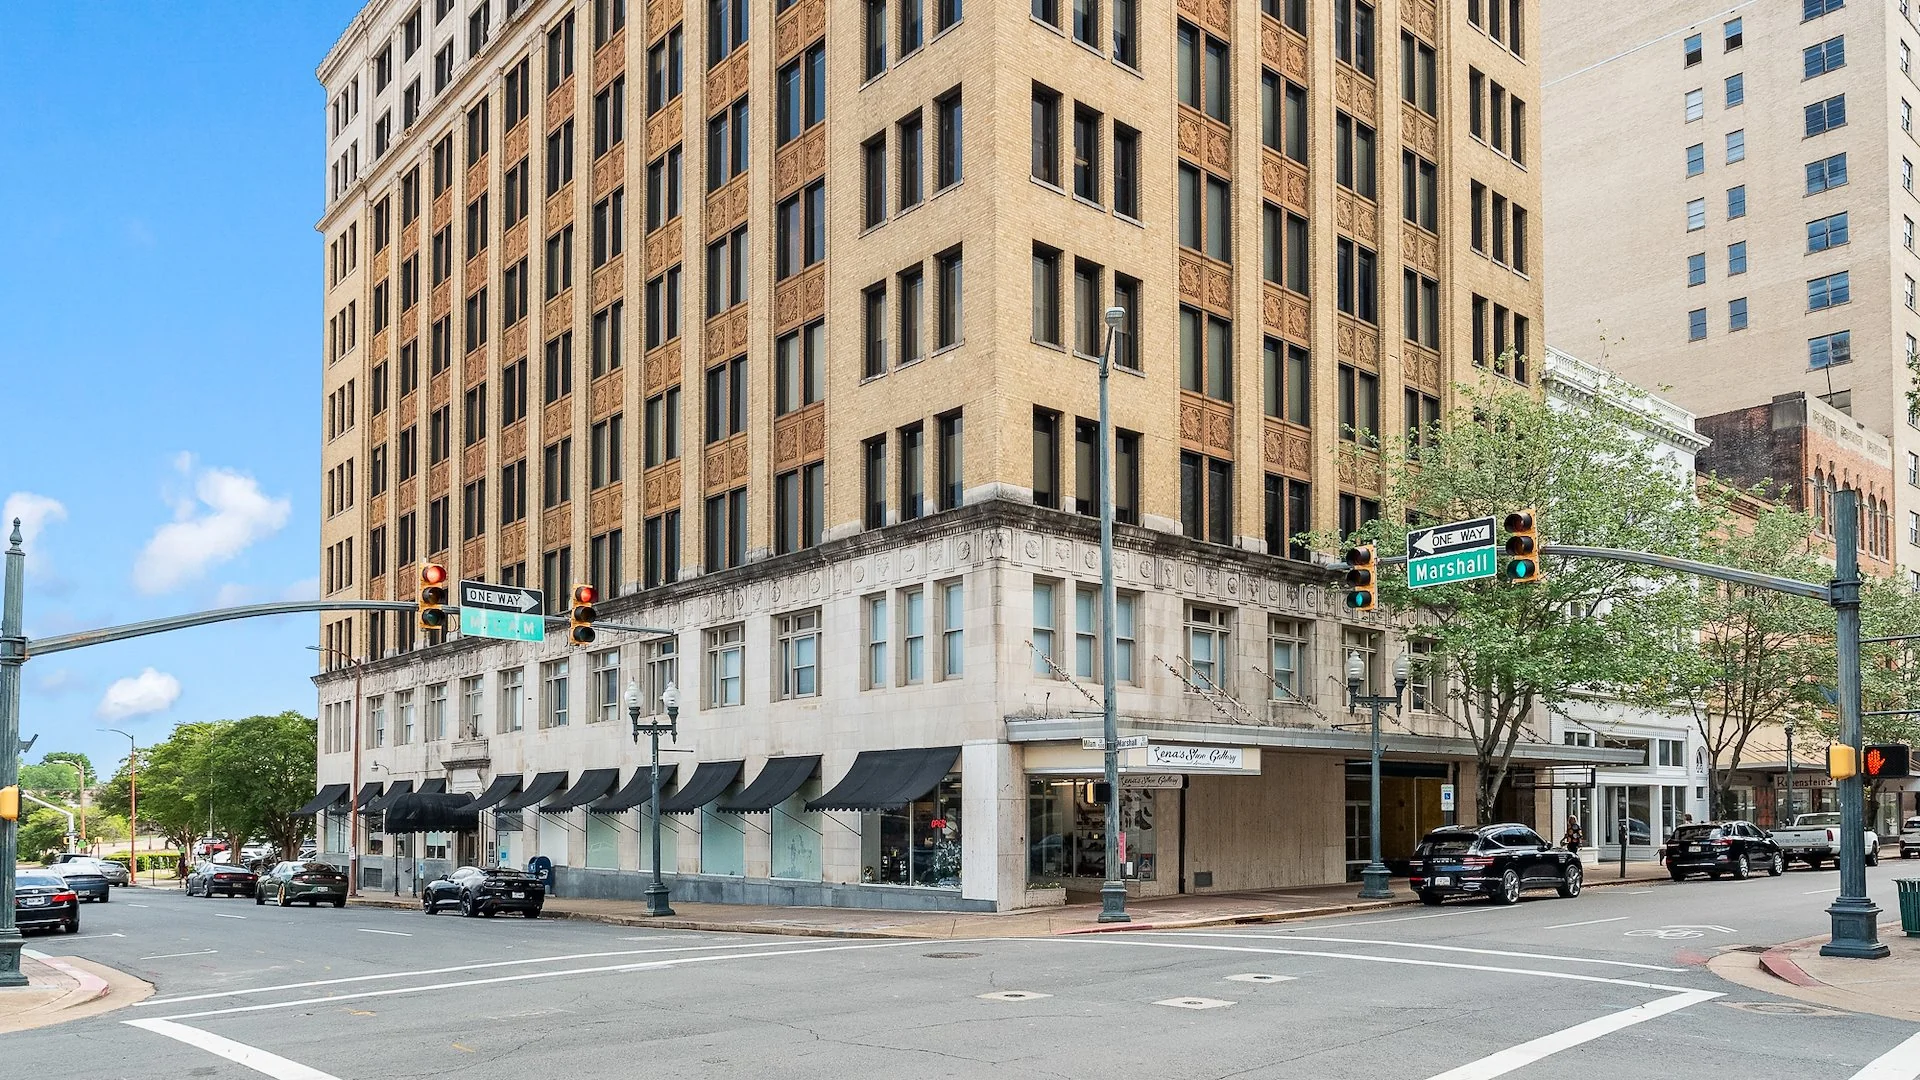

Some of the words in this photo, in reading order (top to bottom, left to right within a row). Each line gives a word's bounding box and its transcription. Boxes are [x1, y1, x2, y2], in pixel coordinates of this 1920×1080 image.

[1432, 533, 1454, 547] ONE
[1460, 527, 1485, 541] WAY
[1416, 553, 1487, 582] Marshall
[470, 589, 493, 602] ONE
[497, 593, 520, 605] WAY
[1154, 746, 1185, 762] Lena's
[1185, 748, 1207, 760] Shoe
[1209, 748, 1237, 764] Gallery
[1777, 775, 1833, 787] Renstein's
